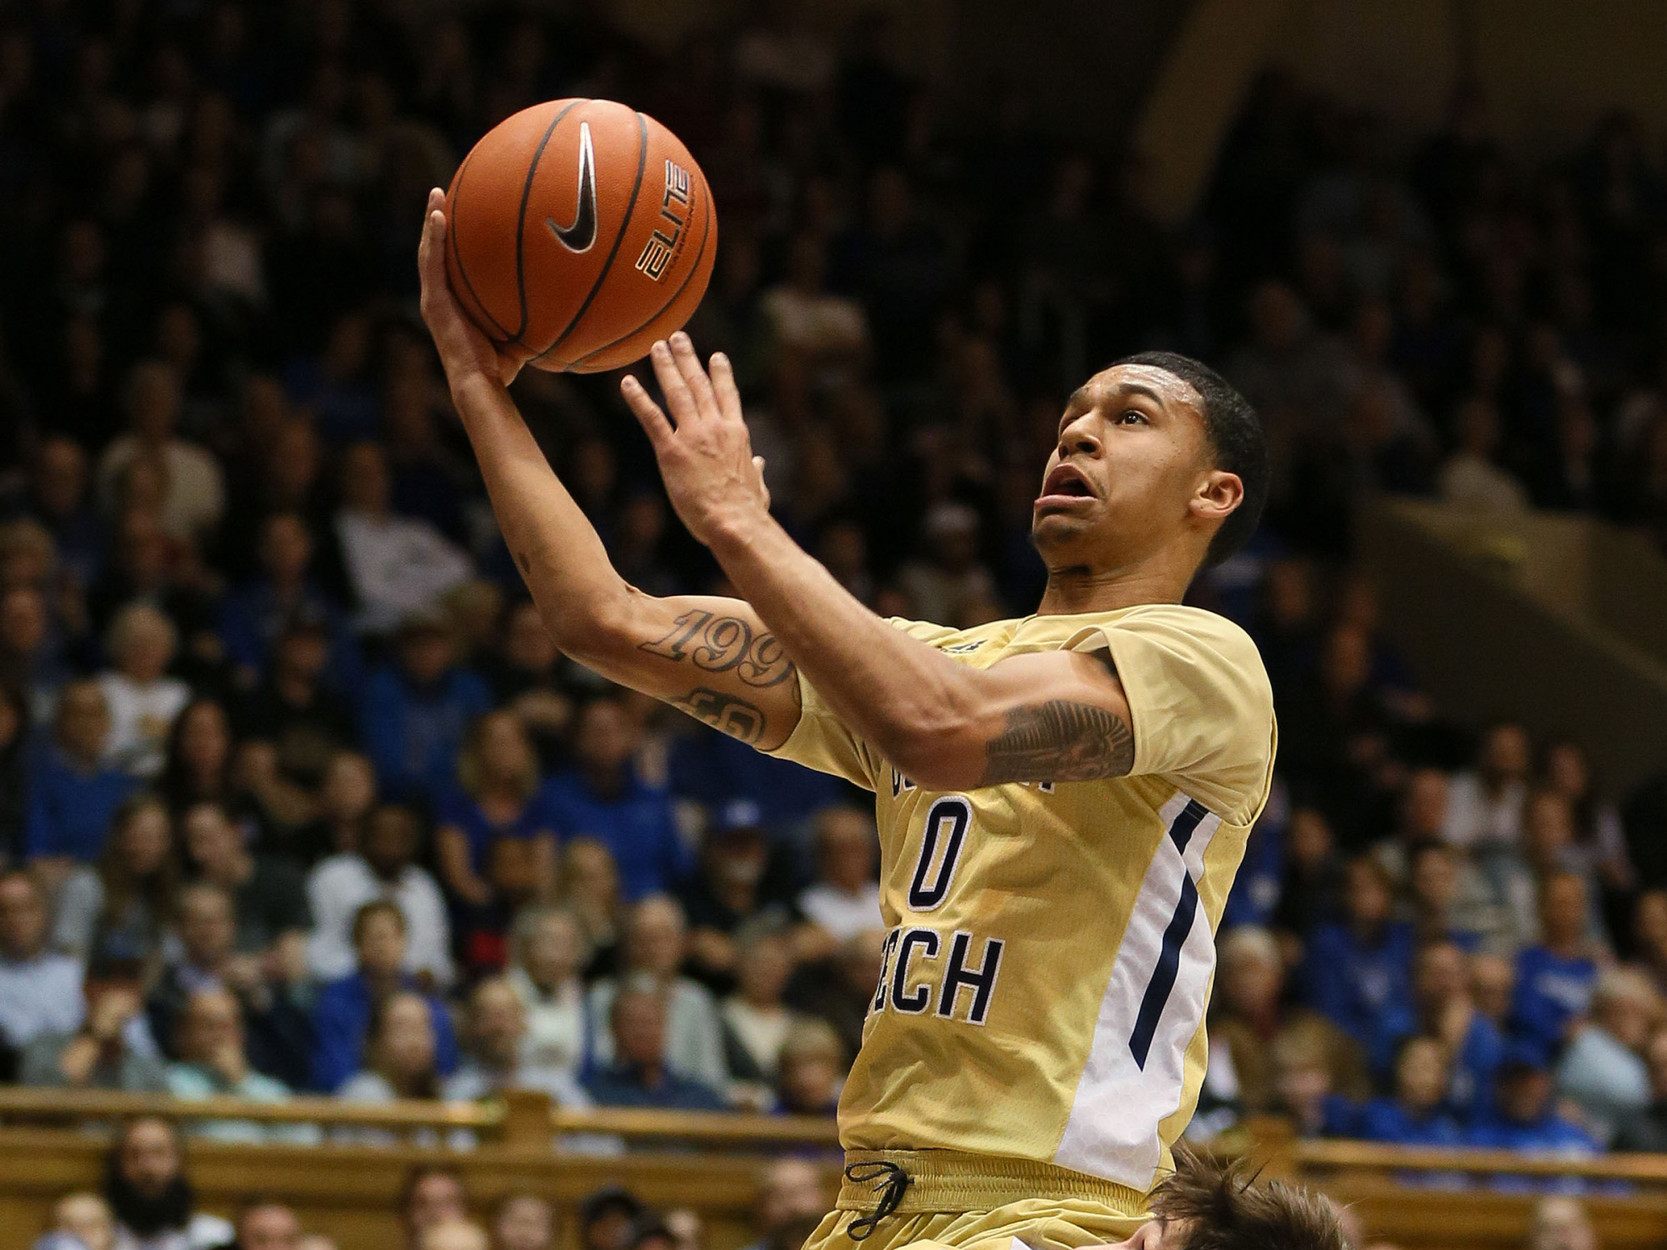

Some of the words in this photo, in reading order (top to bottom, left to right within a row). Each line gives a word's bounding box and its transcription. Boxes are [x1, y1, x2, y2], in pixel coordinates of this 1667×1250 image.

[635, 159, 689, 281] ELITE
[637, 609, 801, 707] 199
[908, 795, 972, 912] 0
[864, 926, 1006, 1026] ECH
